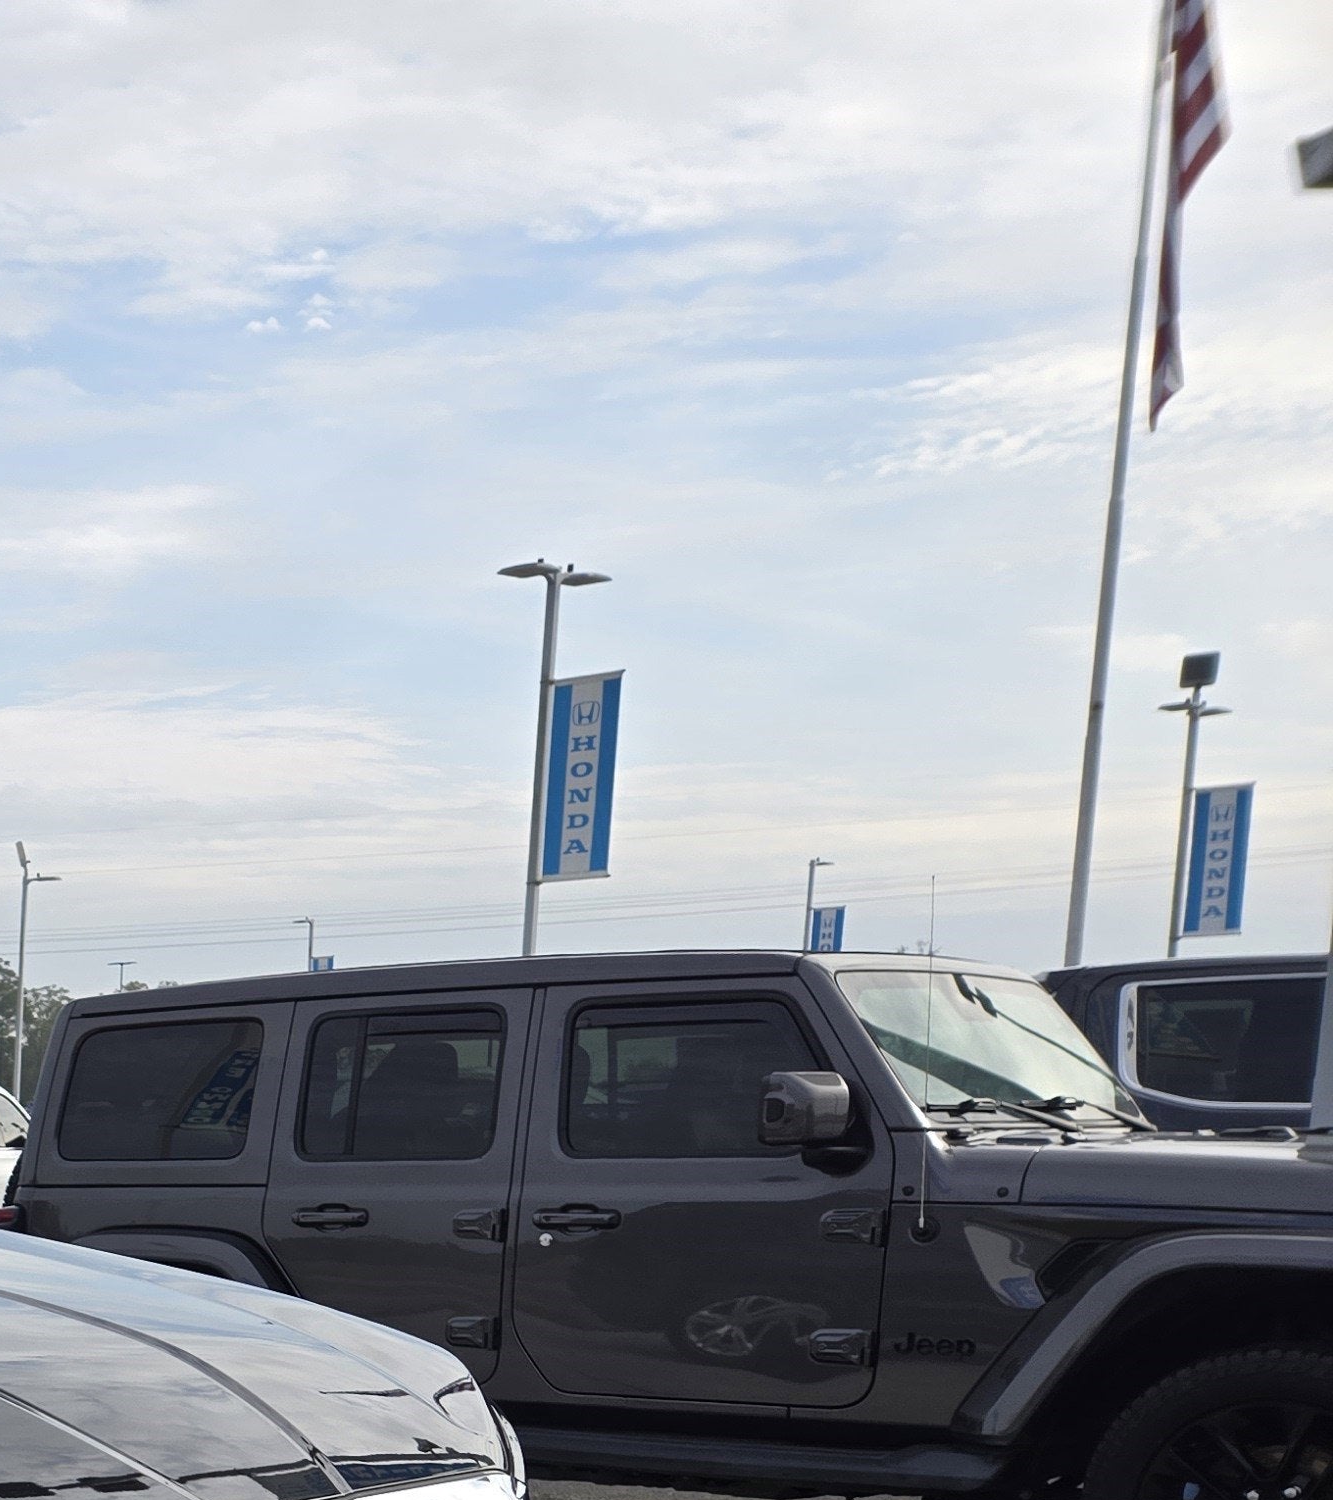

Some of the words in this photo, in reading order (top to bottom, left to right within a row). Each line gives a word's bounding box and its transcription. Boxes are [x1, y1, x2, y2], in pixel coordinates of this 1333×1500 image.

[563, 734, 597, 855] HONDA
[1203, 828, 1232, 918] HONDA
[893, 1332, 976, 1357] Jeep
